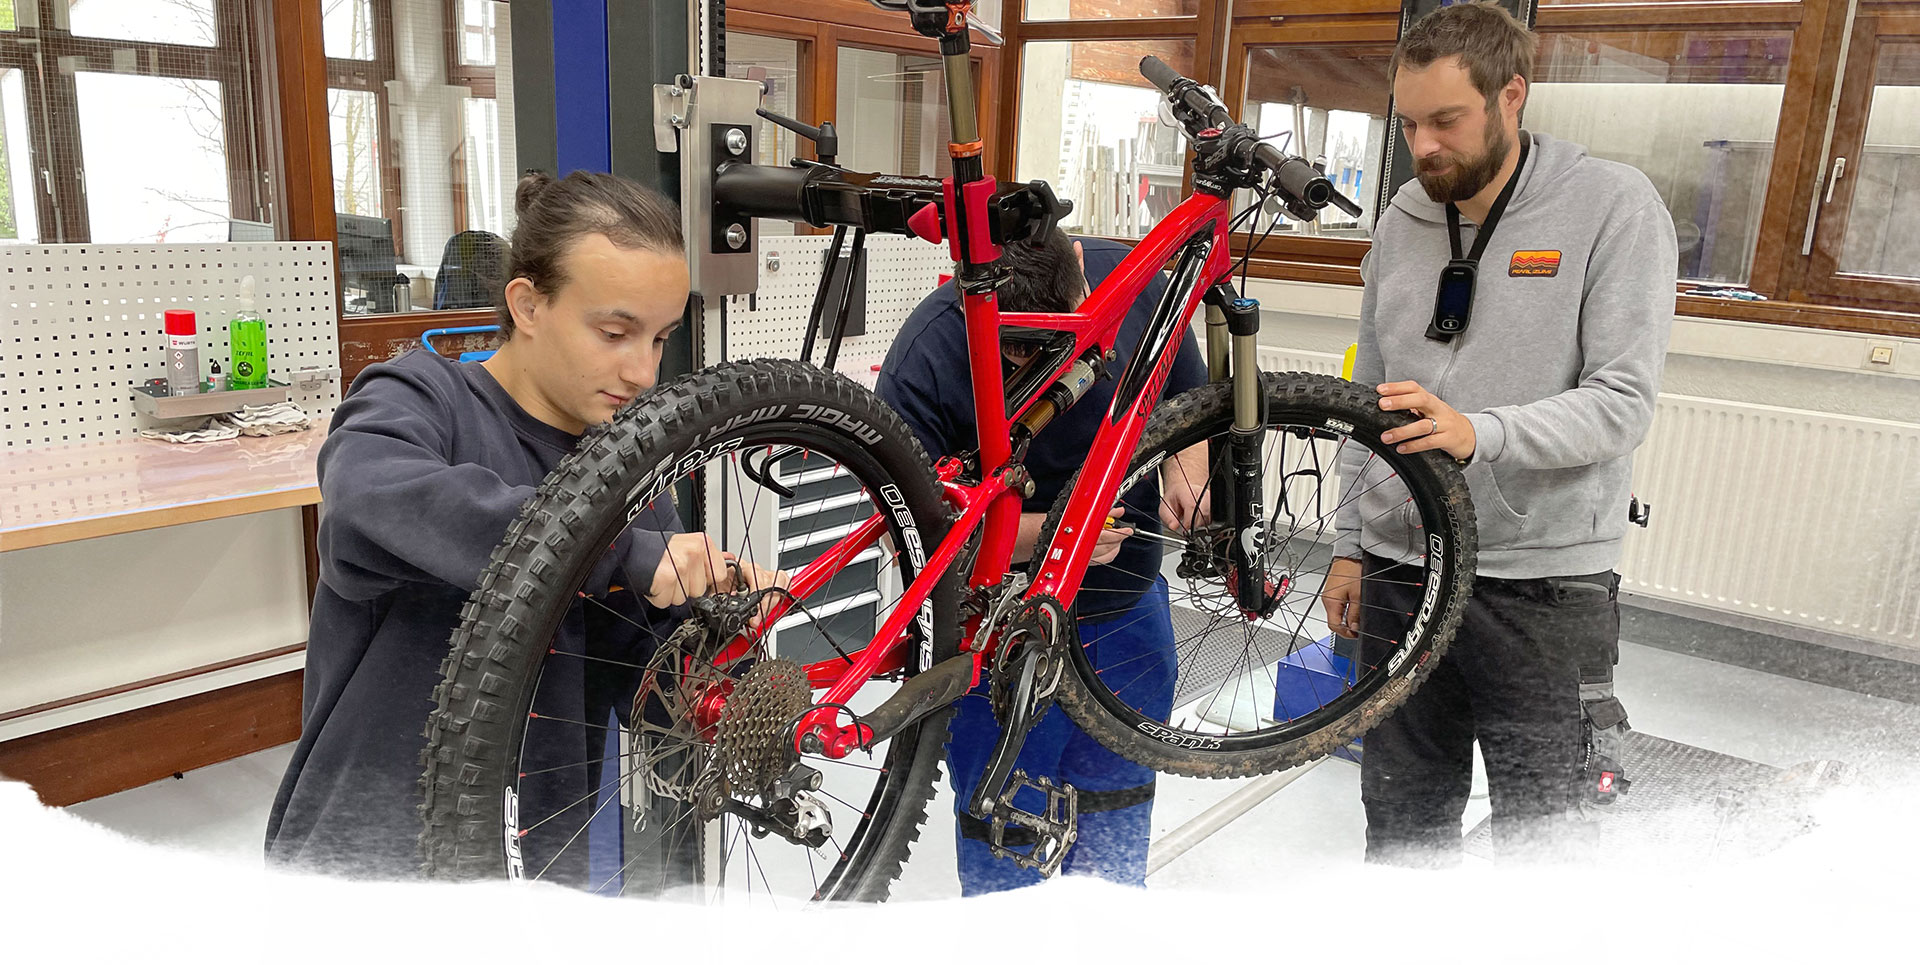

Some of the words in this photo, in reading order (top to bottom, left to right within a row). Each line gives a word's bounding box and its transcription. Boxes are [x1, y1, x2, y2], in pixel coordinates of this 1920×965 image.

[692, 404, 787, 447] MARY
[789, 404, 885, 446] MAGIC
[1050, 547, 1064, 561] M
